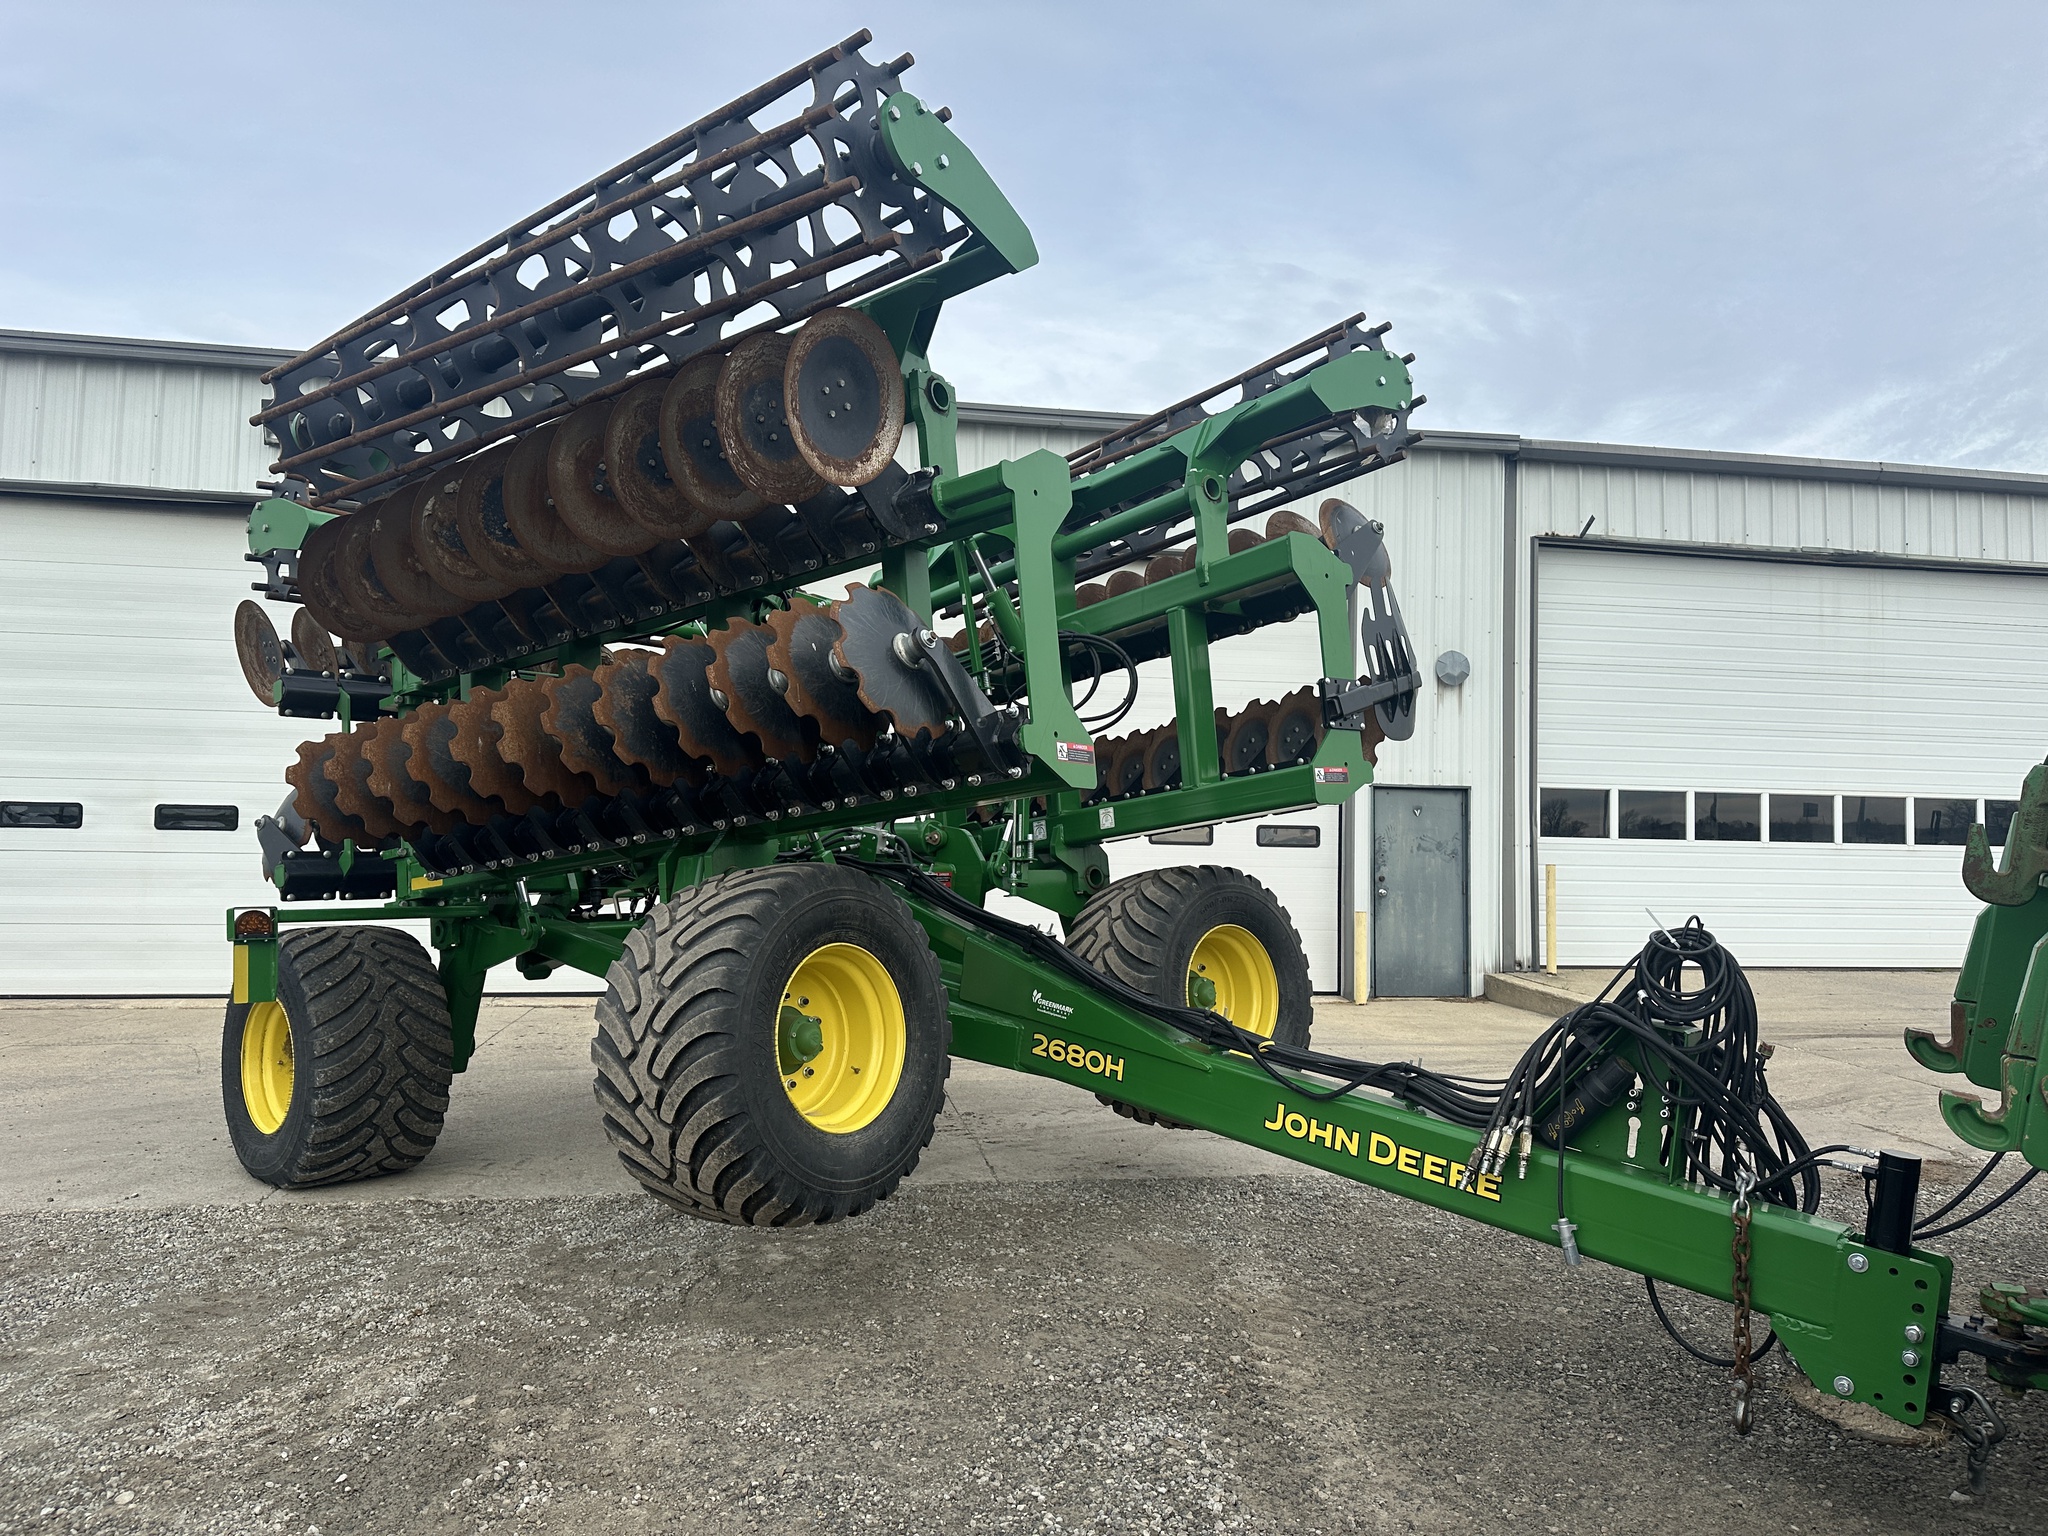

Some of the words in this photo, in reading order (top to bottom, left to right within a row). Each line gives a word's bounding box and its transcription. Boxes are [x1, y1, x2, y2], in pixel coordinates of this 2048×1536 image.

[1037, 998, 1074, 1014] GREENMARK
[1031, 1032, 1125, 1082] 2680H
[1264, 1102, 1361, 1158] JOHN
[1367, 1130, 1503, 1203] DEERE
